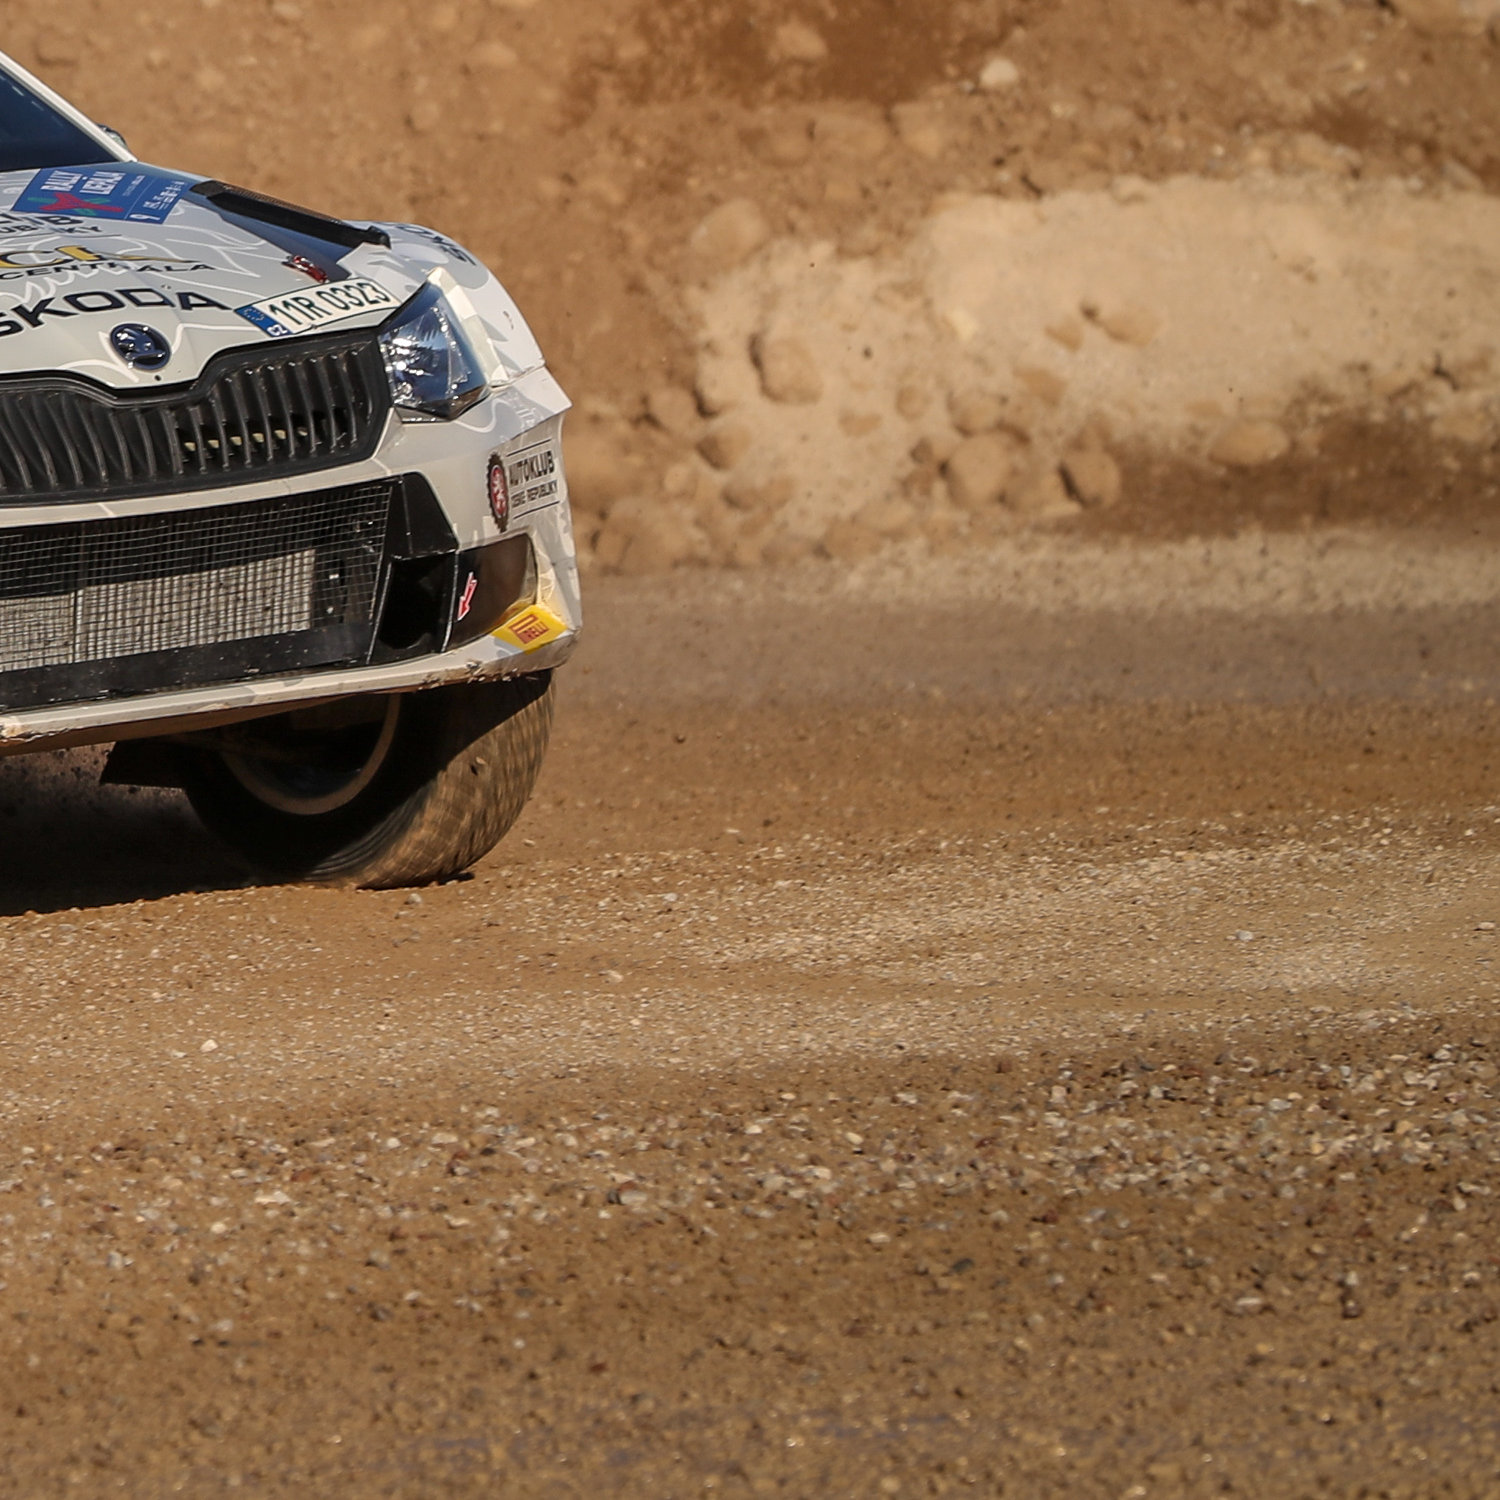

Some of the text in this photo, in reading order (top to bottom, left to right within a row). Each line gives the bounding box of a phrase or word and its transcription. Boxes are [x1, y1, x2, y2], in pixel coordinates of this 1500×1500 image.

[269, 282, 392, 326] 11R 0323
[266, 324, 289, 337] CZ
